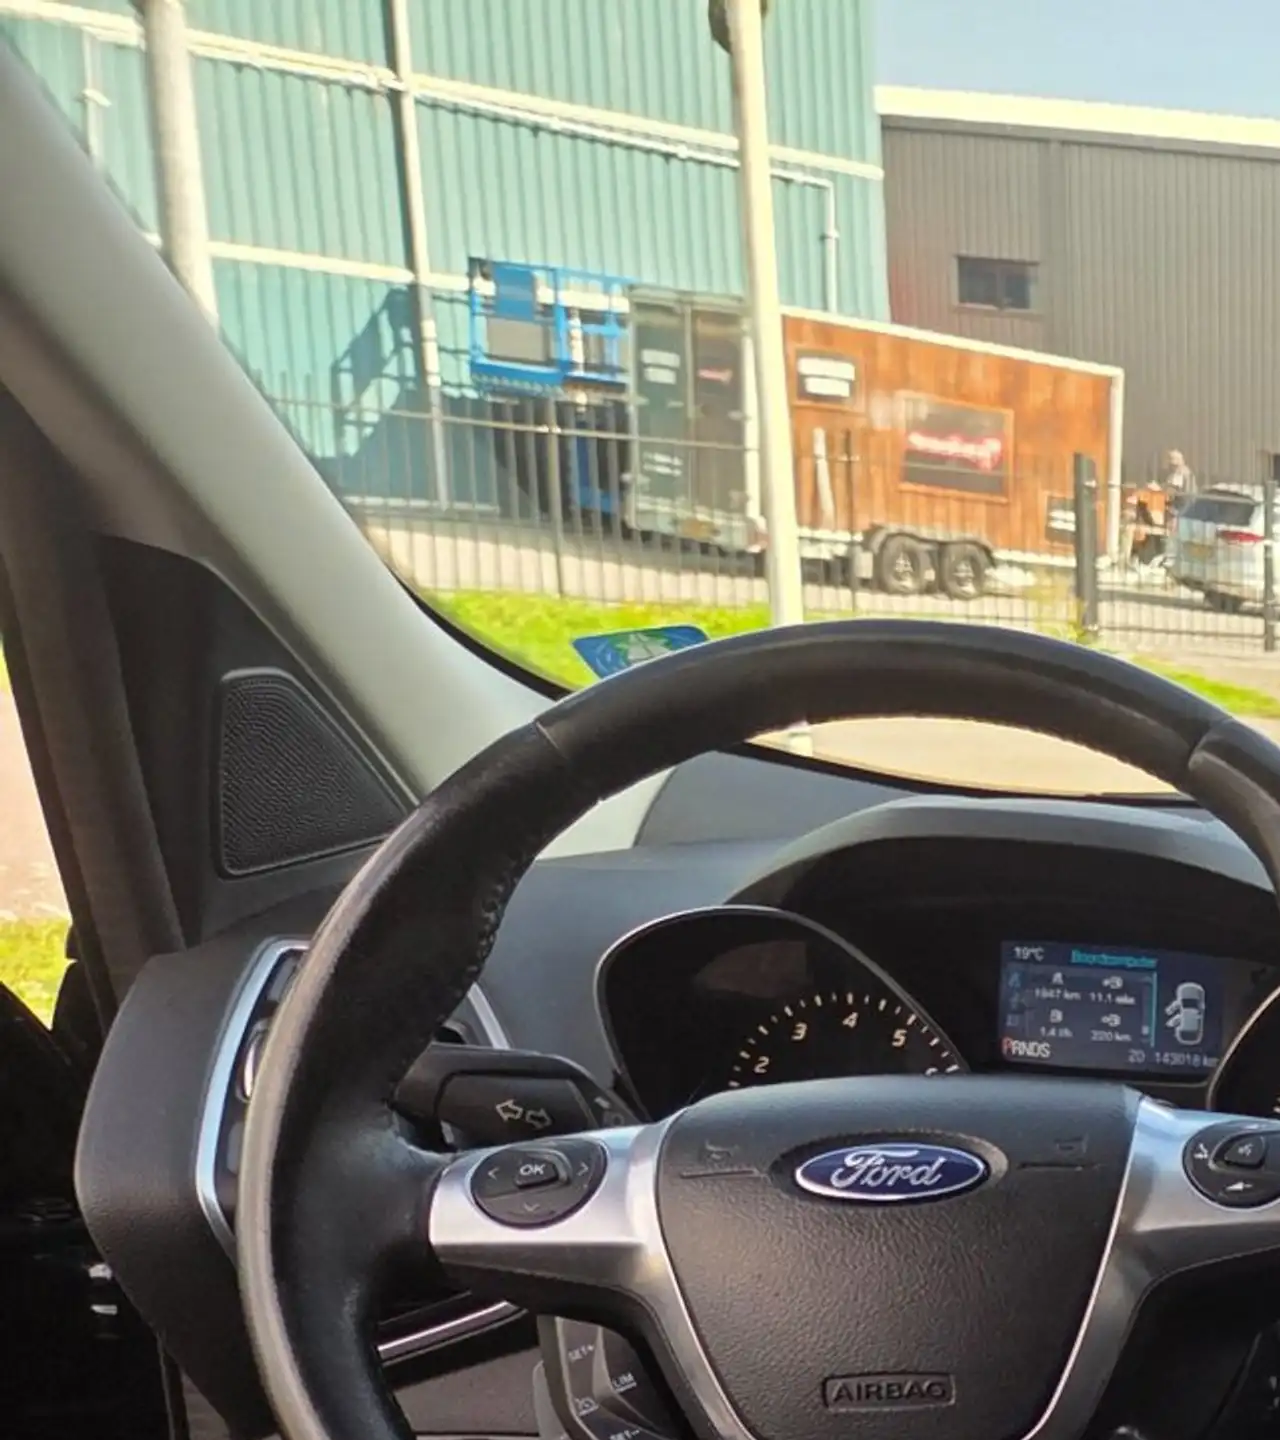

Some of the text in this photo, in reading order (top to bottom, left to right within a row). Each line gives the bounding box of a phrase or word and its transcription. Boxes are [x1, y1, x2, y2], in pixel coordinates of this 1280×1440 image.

[842, 1012, 859, 1029] 4
[791, 1023, 808, 1041] 3
[892, 1029, 907, 1047] 5
[754, 1056, 770, 1073] 2
[519, 1163, 546, 1176] OK
[830, 1148, 941, 1189] Ford
[832, 1379, 948, 1402] AIRBAG
